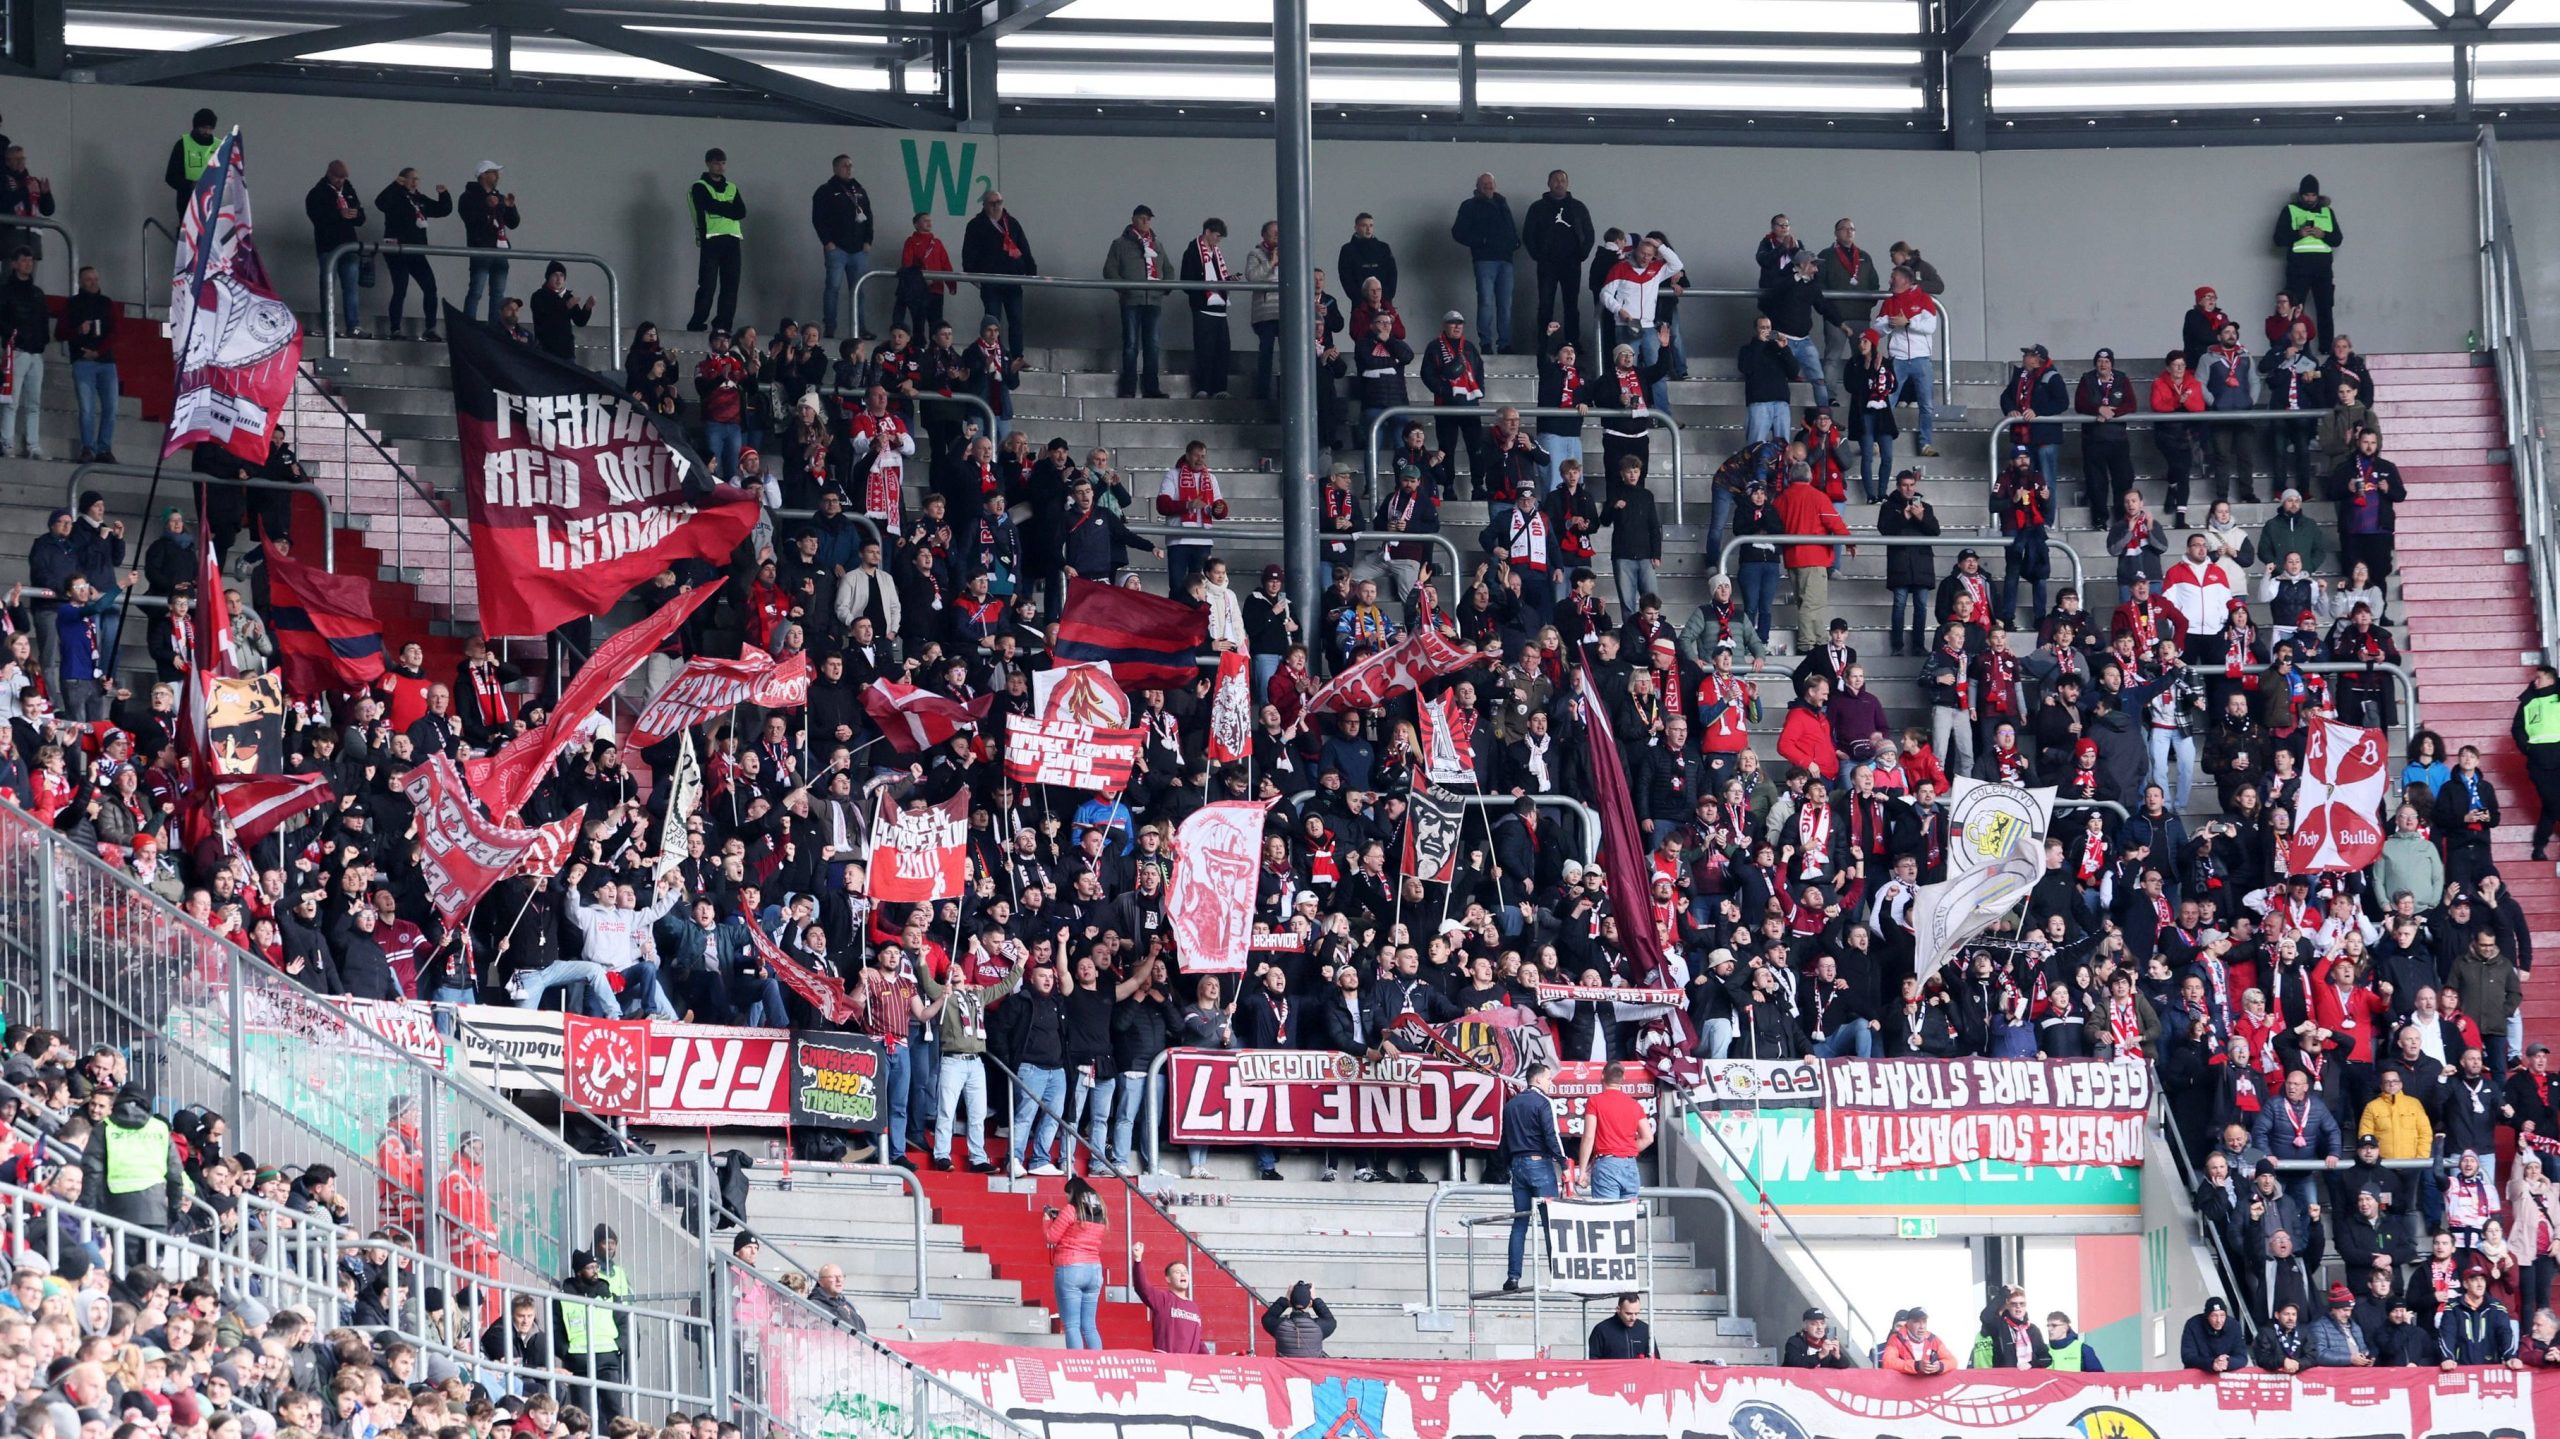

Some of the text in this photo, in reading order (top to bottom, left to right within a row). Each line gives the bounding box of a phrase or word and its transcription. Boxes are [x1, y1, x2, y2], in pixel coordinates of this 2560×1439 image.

[2340, 829, 2377, 845] Bulls
[816, 1069, 861, 1095] GEGEN
[1240, 1055, 1330, 1080] JUGEND
[1181, 1065, 1295, 1133] 147
[1832, 1060, 2149, 1110] GEGEN EURE STRAFEN
[803, 1087, 875, 1119] RASENBALL
[1313, 1071, 1496, 1135] ZONE
[2040, 1115, 2145, 1163] UNSERE
[1550, 1218, 1636, 1255] TIFO
[1552, 1257, 1637, 1281] LIBERO
